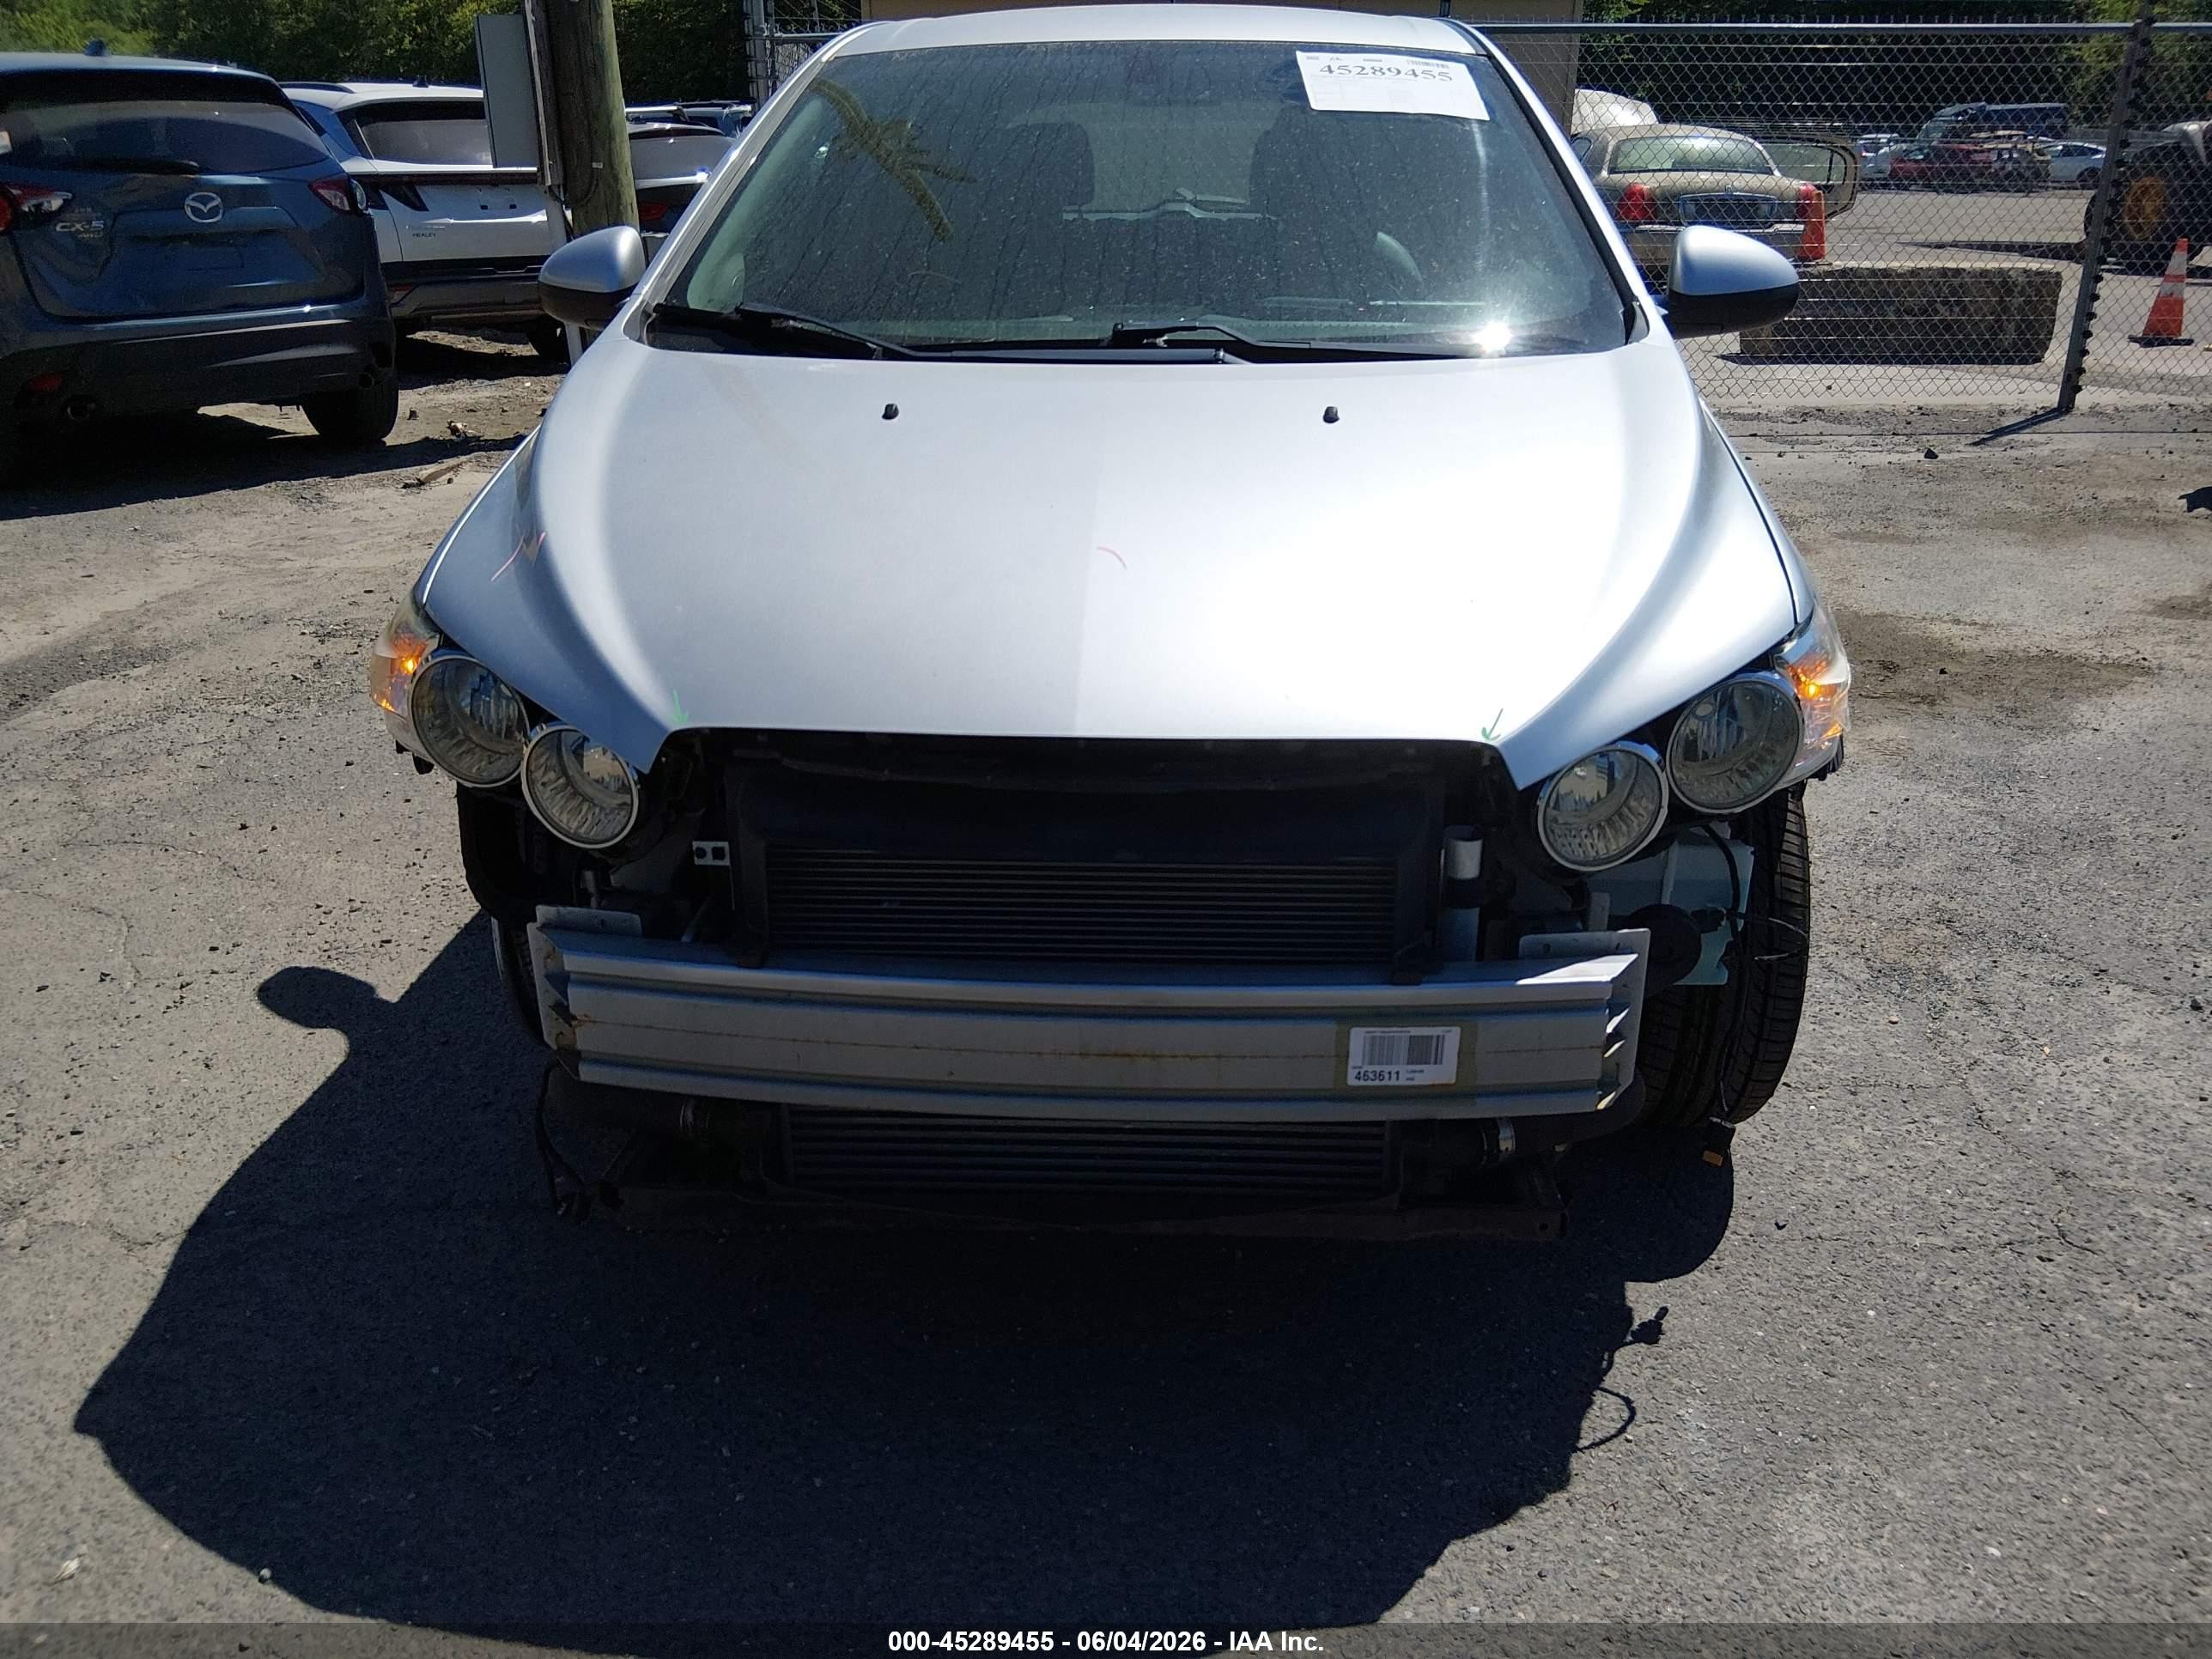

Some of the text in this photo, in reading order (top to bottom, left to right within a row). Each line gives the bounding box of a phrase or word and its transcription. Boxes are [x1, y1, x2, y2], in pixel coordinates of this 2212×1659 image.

[1319, 64, 1453, 82] 45289455
[55, 220, 104, 232] CX-5
[1354, 1070, 1401, 1082] 463611
